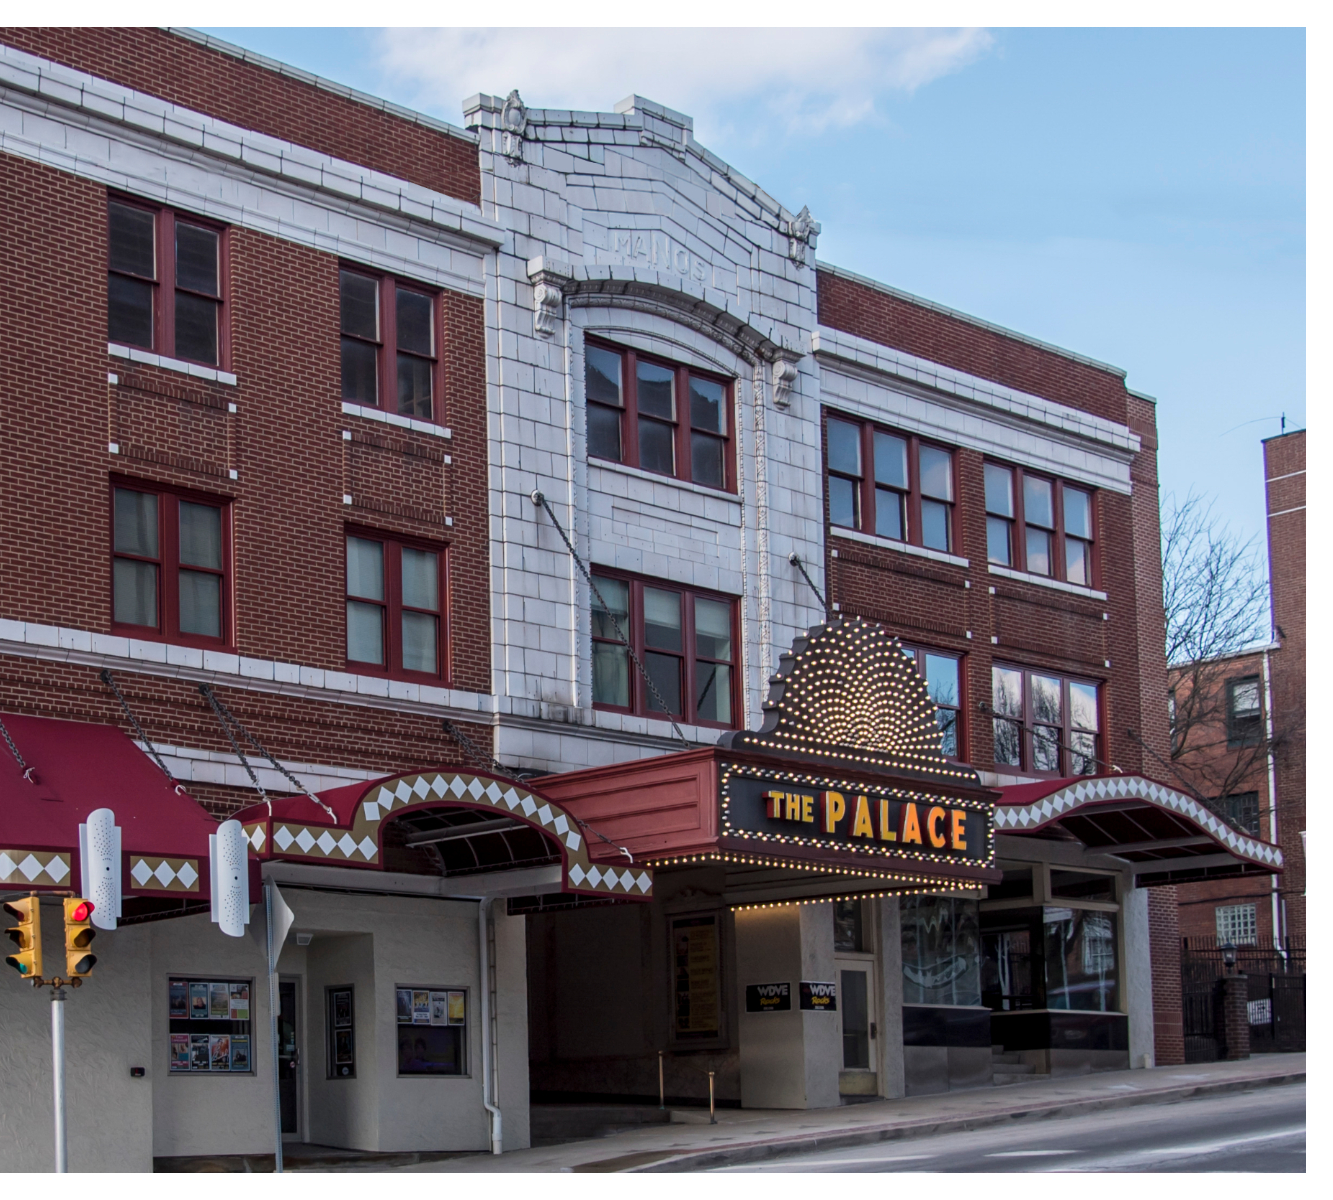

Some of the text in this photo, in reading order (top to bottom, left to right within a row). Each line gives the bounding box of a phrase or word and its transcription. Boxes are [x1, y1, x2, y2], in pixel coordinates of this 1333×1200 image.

[614, 230, 706, 281] MANOS
[763, 790, 967, 850] THE PALACE
[757, 985, 788, 996] WDVE
[809, 984, 836, 996] WDVE
